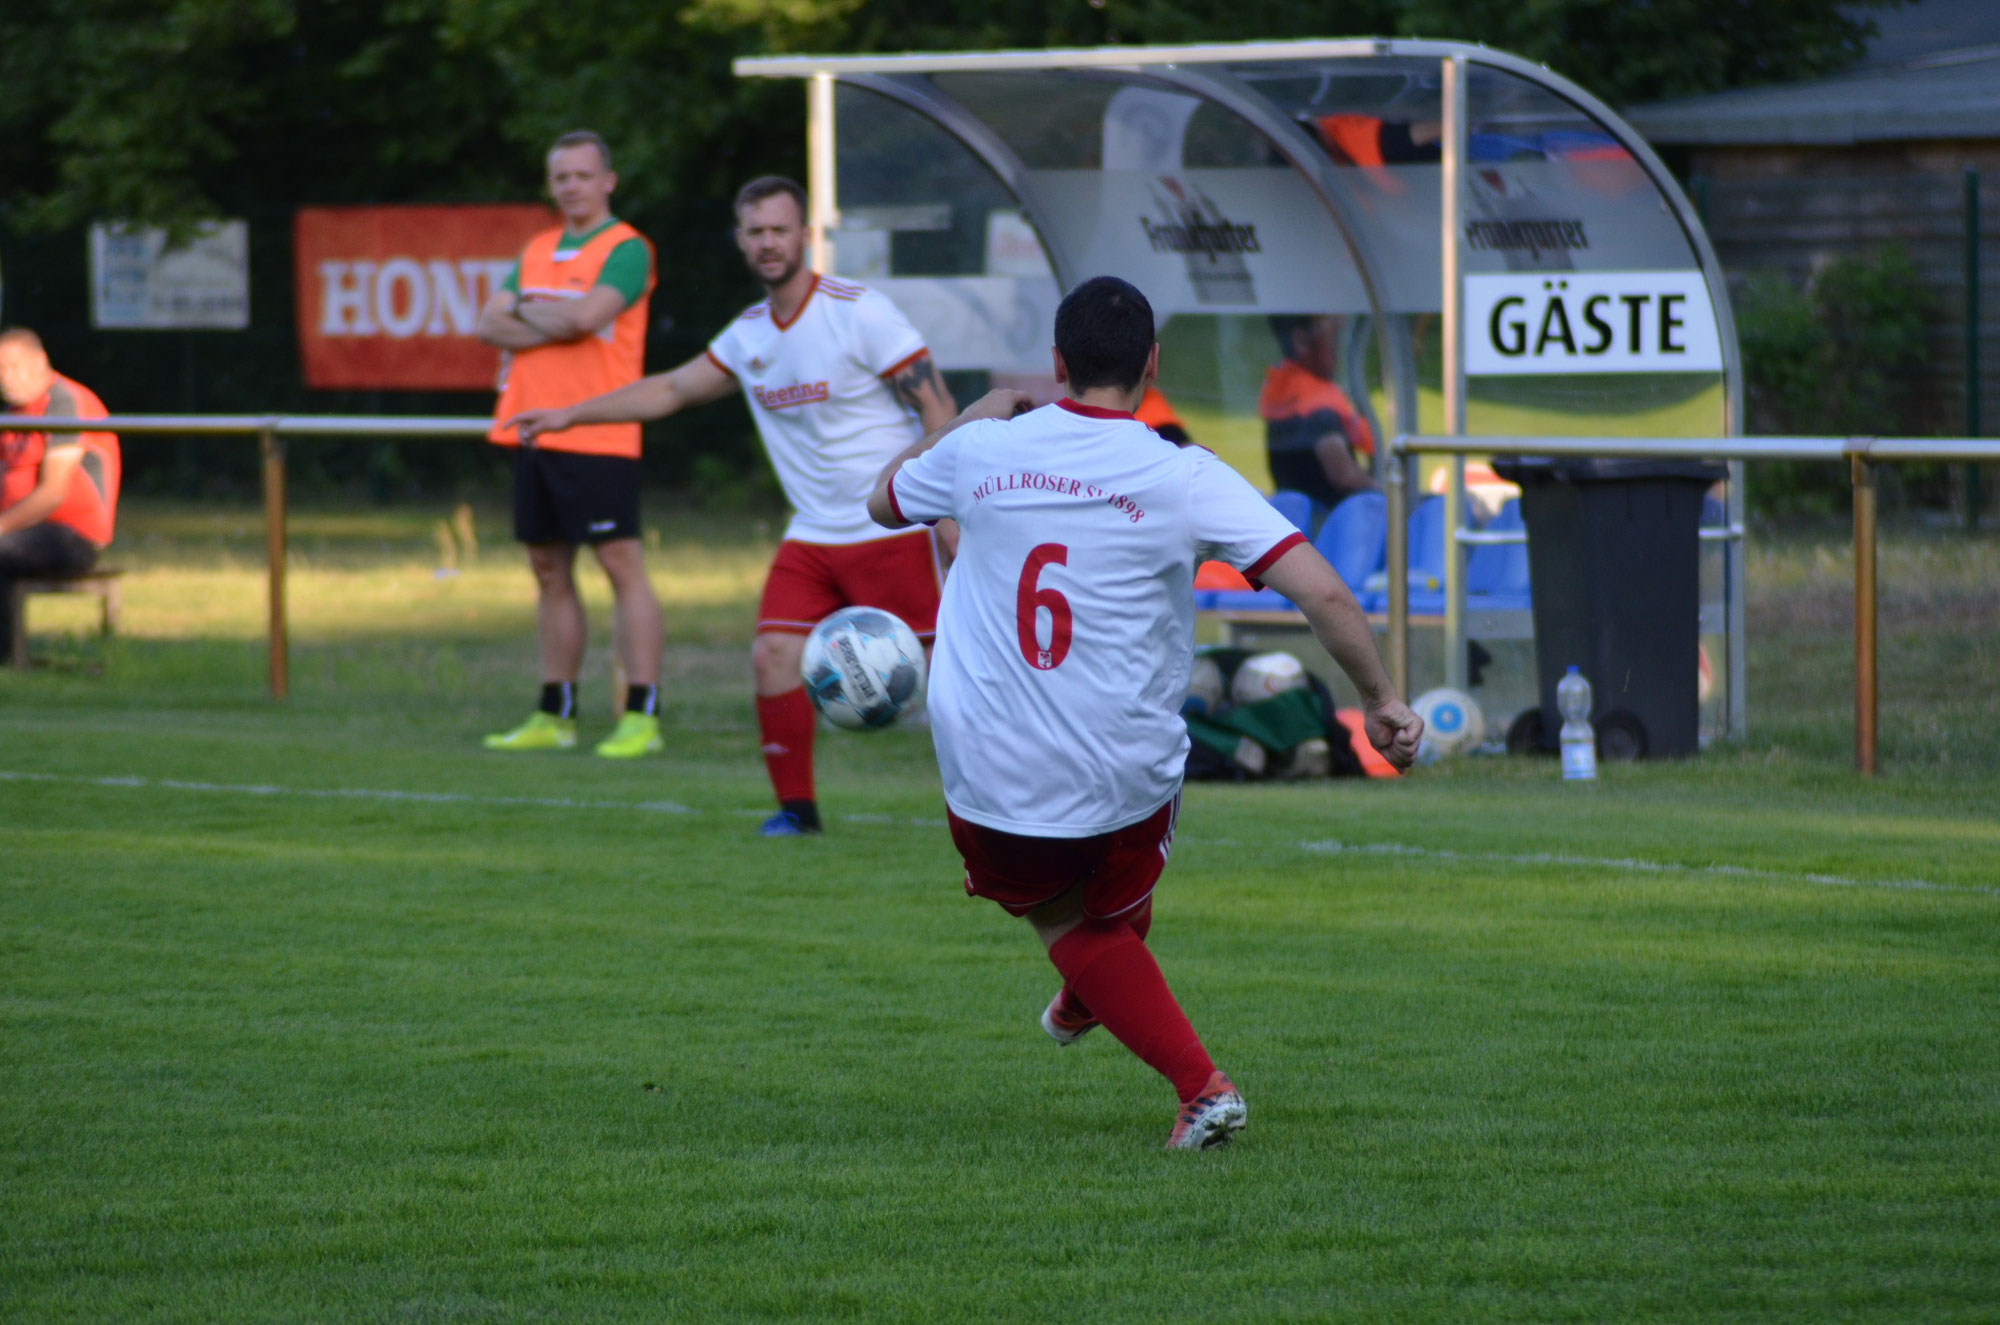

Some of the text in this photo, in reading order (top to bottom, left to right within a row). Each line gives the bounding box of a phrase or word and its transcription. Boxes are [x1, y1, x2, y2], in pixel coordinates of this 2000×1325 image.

[1139, 215, 1262, 264] Frankfurter
[1488, 279, 1686, 358] GÄSTE
[753, 379, 829, 410] Heering
[972, 473, 1081, 505] MÜLLROSER
[1108, 492, 1145, 523] 1898
[1017, 542, 1073, 671] 6
